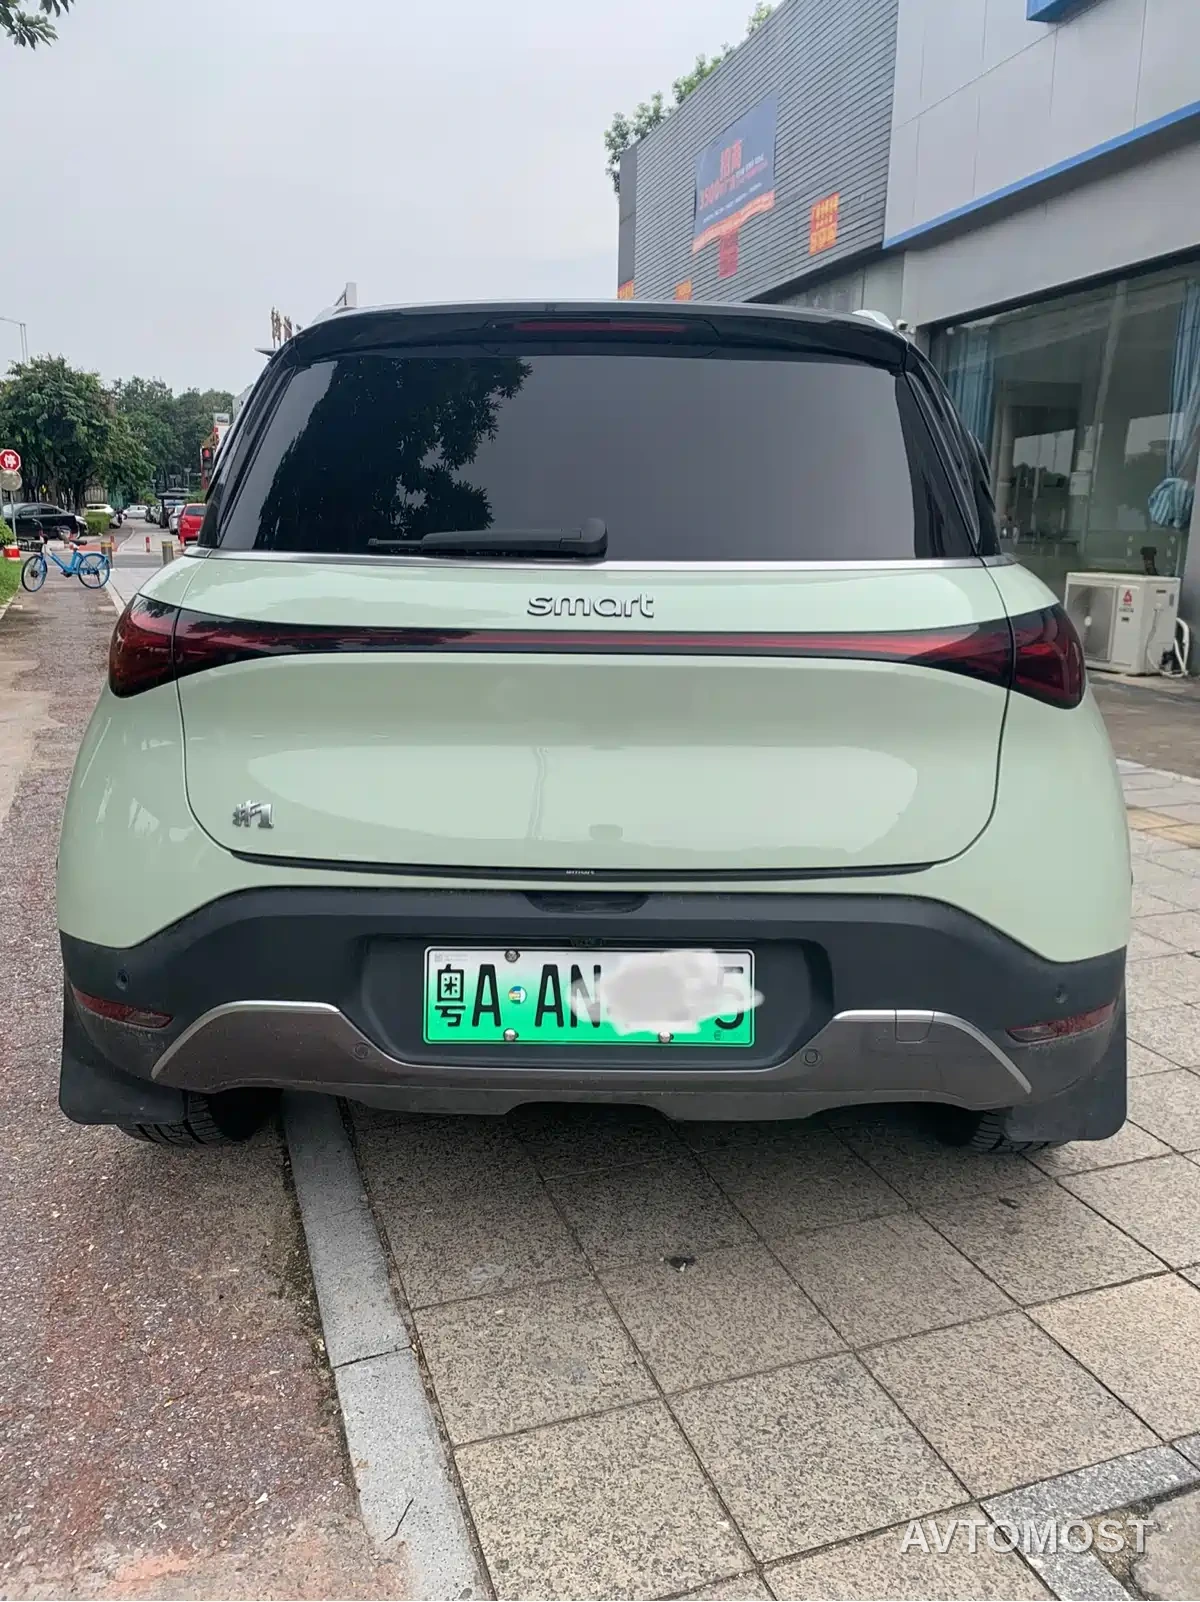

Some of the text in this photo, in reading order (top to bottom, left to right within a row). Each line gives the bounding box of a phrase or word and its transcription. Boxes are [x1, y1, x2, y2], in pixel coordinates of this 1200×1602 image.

[4, 454, 17, 468] 停
[527, 593, 654, 618] smart
[232, 800, 274, 829] #1
[435, 963, 745, 1030] 粤A AN5
